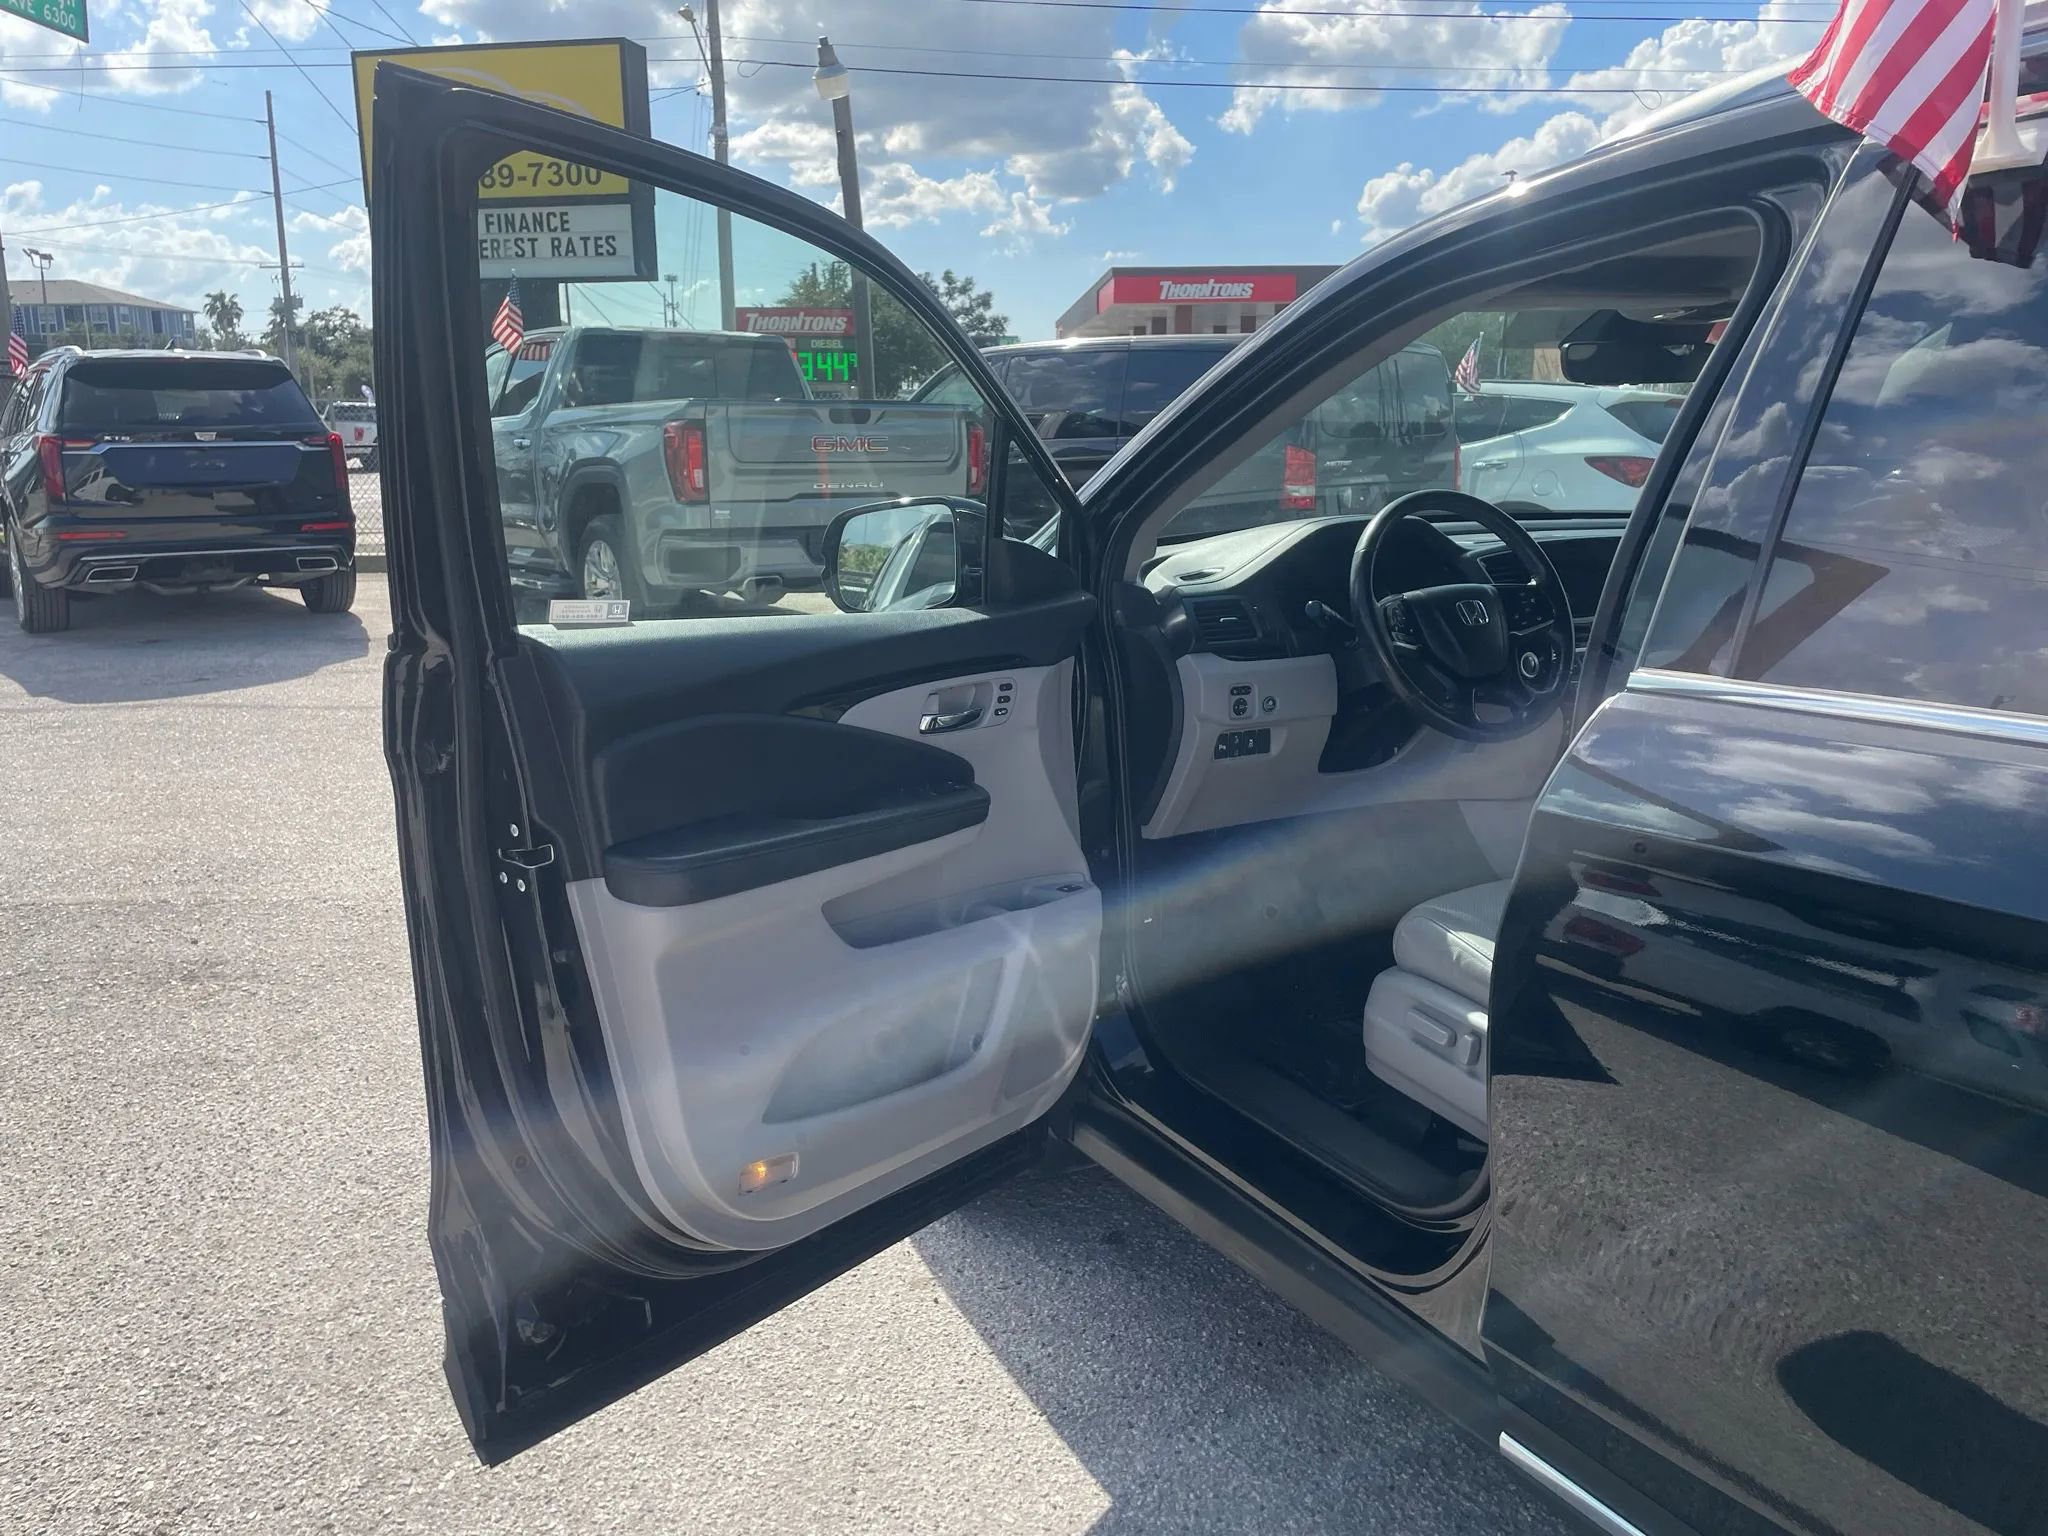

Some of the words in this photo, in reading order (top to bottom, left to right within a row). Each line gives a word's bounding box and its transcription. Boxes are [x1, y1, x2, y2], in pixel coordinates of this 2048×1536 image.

[44, 4, 76, 30] 6300
[484, 211, 571, 234] FINANCE
[550, 235, 617, 258] RATES
[1159, 279, 1255, 300] THORNTONS
[745, 312, 848, 333] THORNTONS
[810, 339, 843, 349] DIESEL
[811, 435, 889, 452] GMC
[813, 481, 884, 489] DENALI
